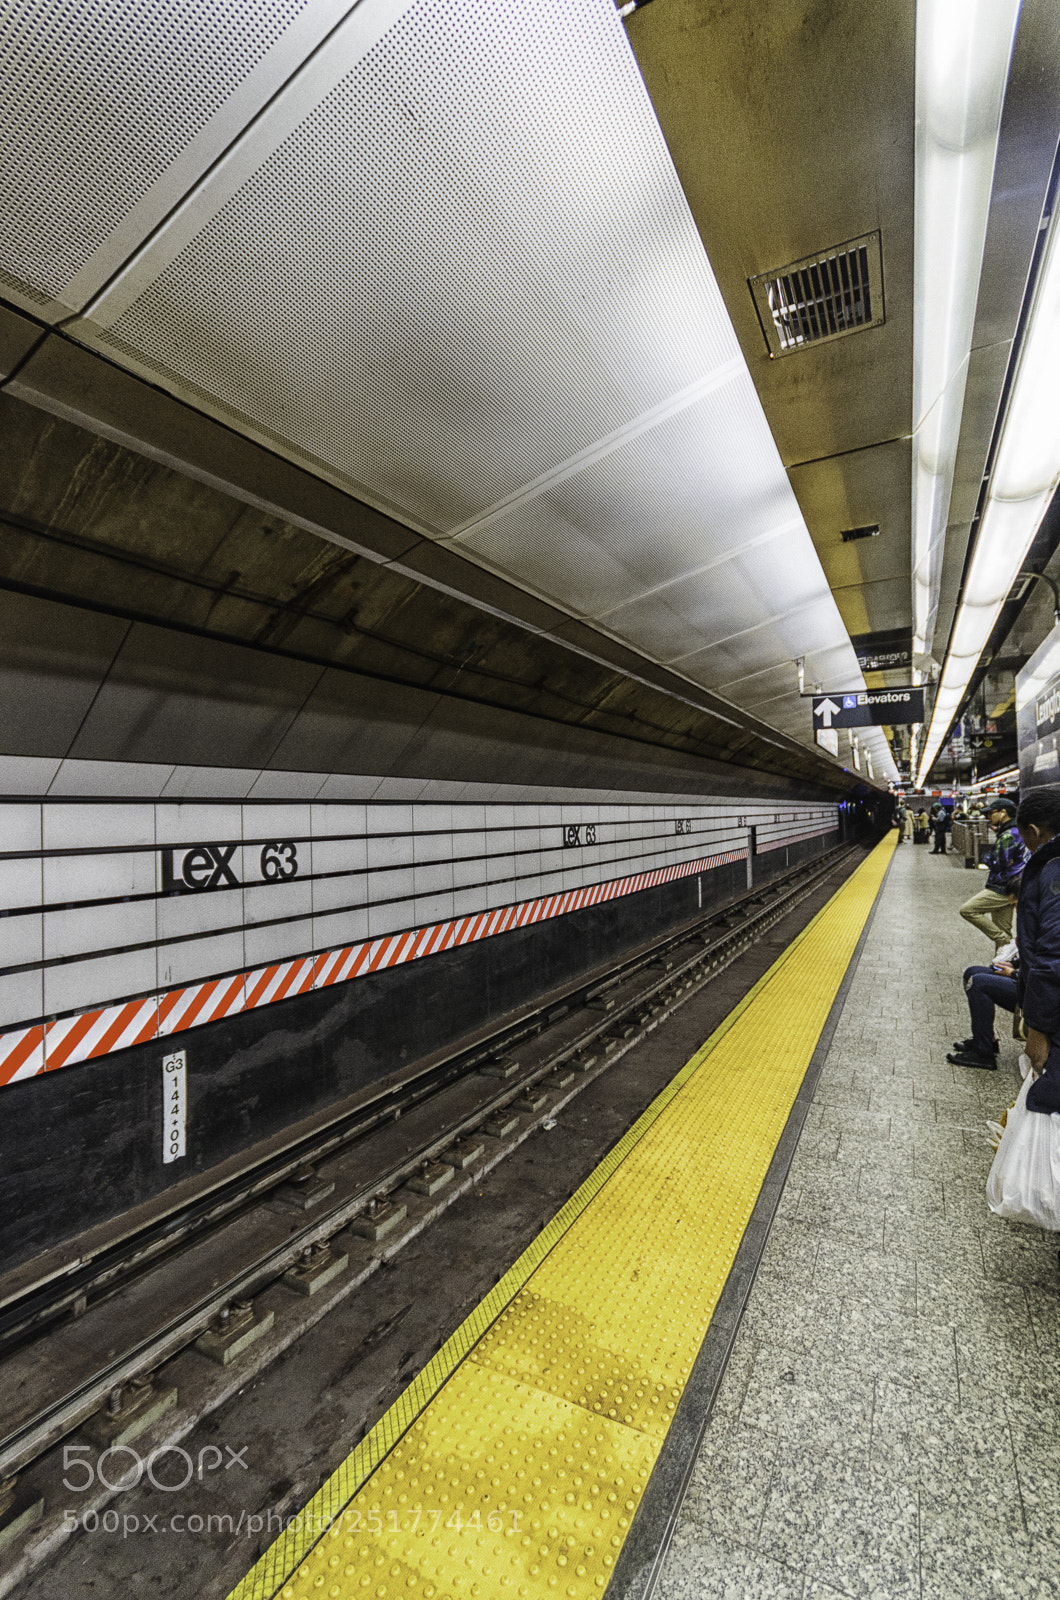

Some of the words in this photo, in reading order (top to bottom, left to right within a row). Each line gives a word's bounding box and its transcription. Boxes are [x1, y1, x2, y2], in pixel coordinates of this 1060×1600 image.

[857, 693, 911, 705] Elevators
[563, 825, 581, 847] Lex
[586, 825, 596, 845] 63
[161, 847, 240, 892] Lex
[260, 842, 299, 881] 63
[165, 1058, 183, 1073] G3
